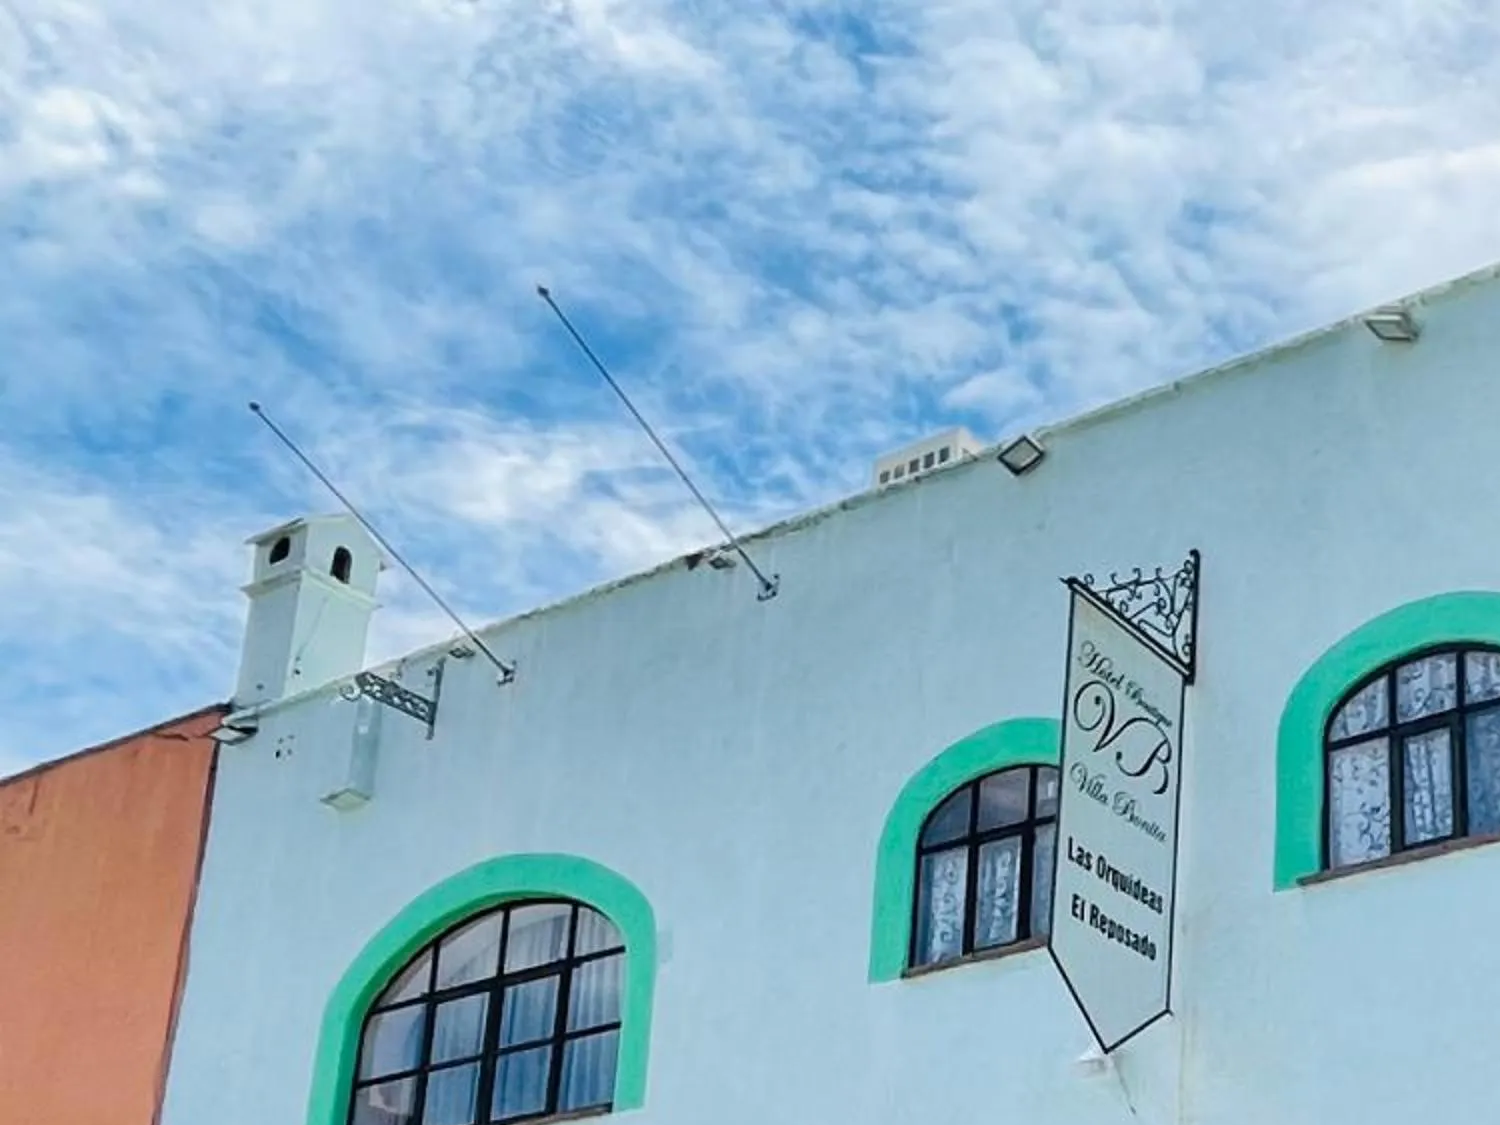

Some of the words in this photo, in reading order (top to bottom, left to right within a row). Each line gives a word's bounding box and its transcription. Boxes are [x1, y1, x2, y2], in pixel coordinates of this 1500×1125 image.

[1070, 762, 1109, 806] Villa
[1068, 836, 1092, 871] Las
[1096, 855, 1164, 915] Orquideas
[1071, 892, 1086, 922] El
[1089, 902, 1157, 961] Reposado
